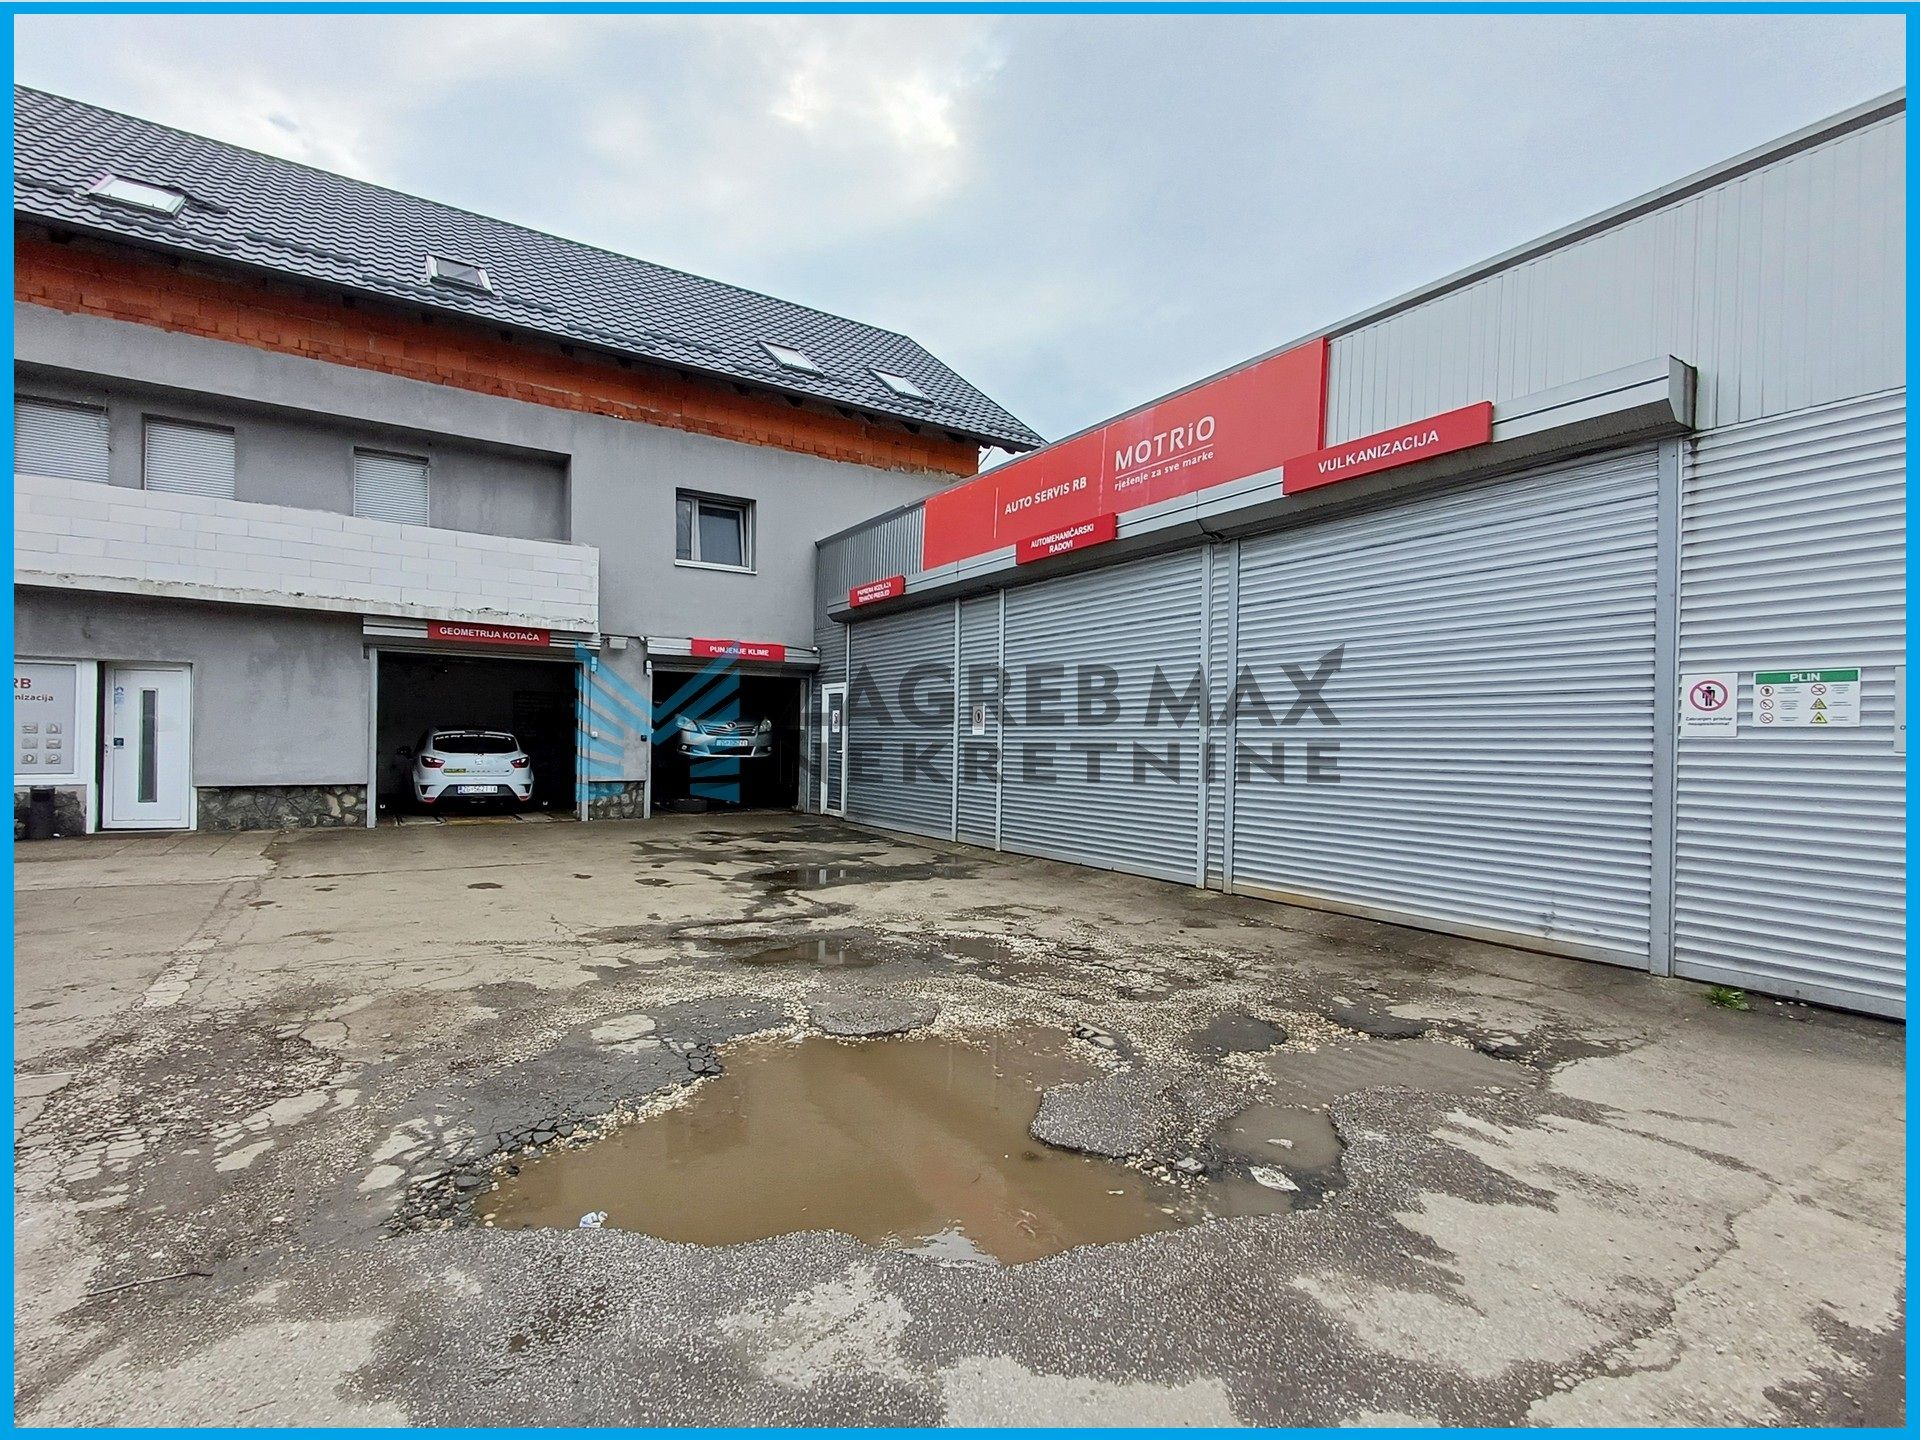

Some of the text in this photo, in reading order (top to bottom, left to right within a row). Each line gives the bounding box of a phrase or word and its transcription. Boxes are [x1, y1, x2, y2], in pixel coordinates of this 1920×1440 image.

[1318, 430, 1440, 474] VULKANIZACIJA
[1114, 450, 1214, 491] rješenje za sve marke
[1004, 476, 1088, 515] AUTO SERVIS RB
[1030, 523, 1094, 548] AUTOMEHANIČARSKI
[1048, 540, 1074, 554] RADOVI
[440, 626, 540, 641] GEOMETRIJA KOTAČA
[709, 645, 770, 657] PUNJENJE KLIME
[1789, 672, 1821, 682] PLIN
